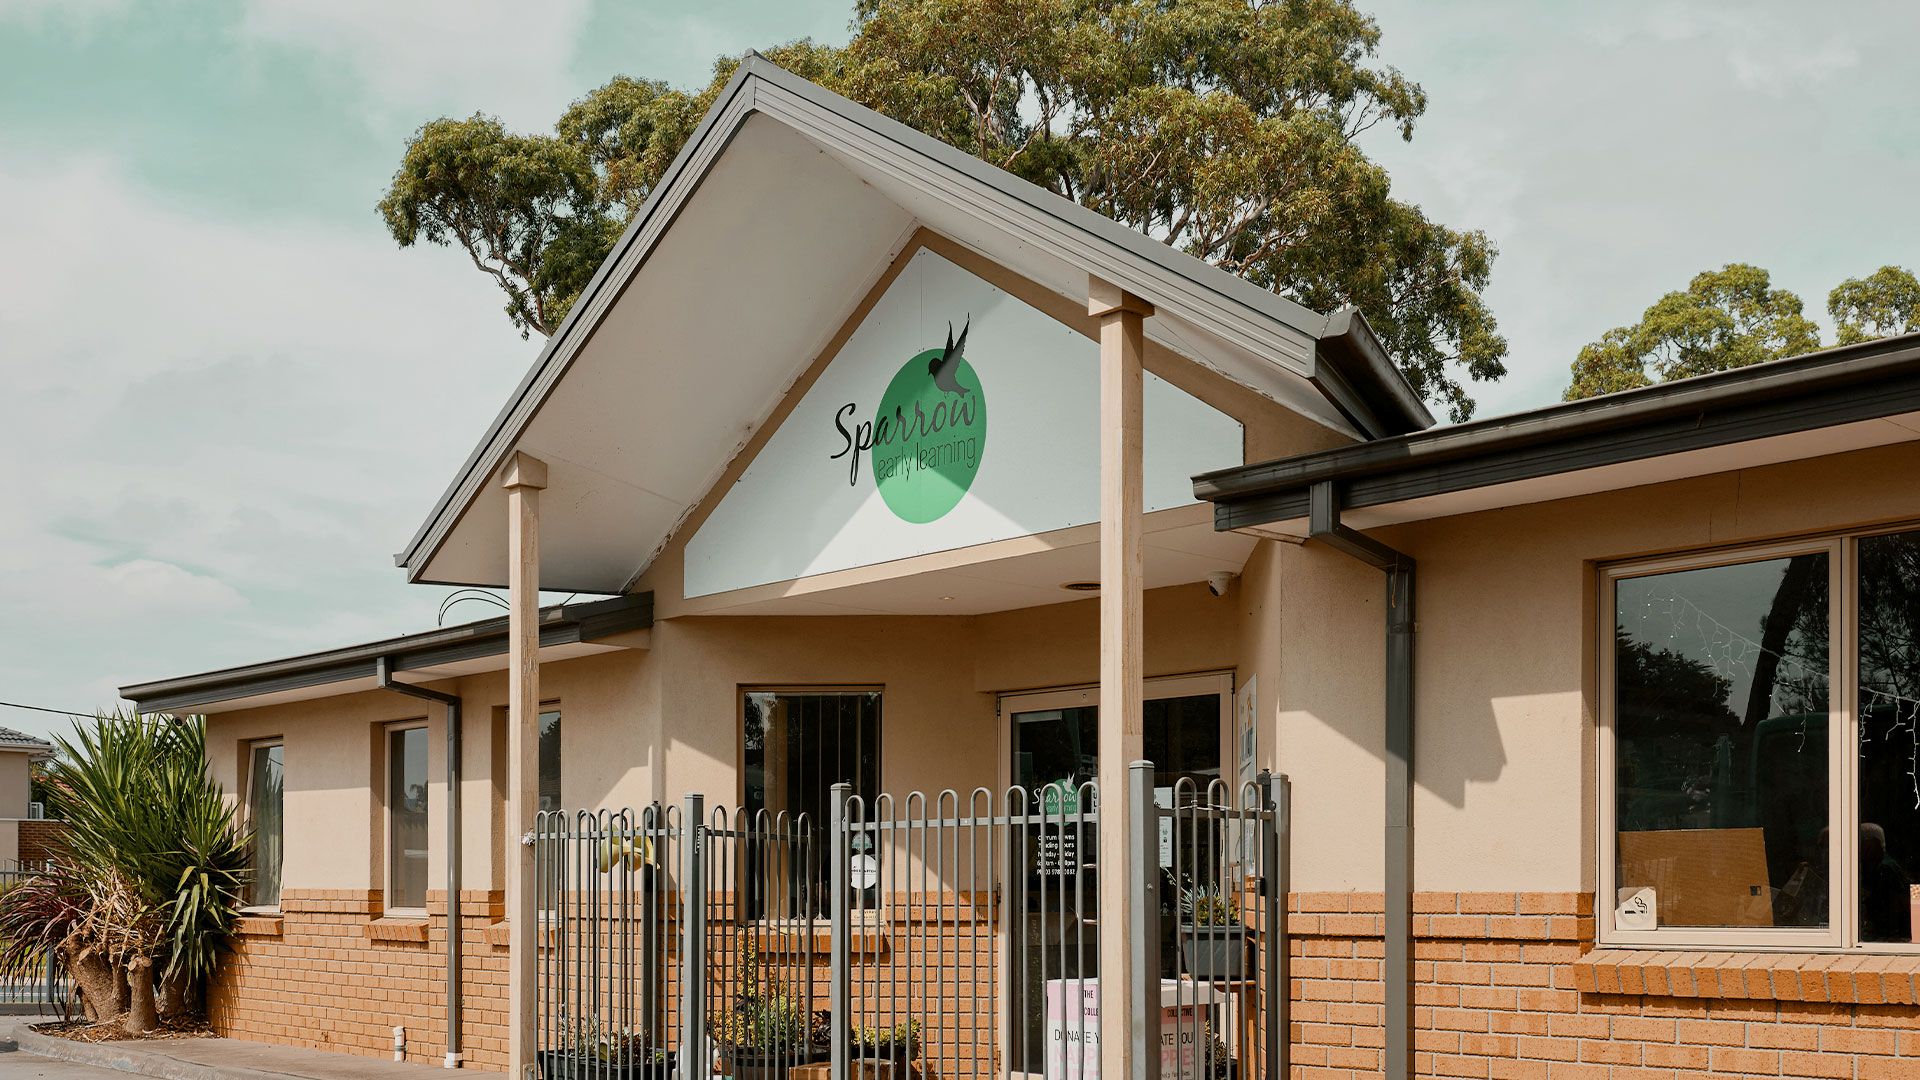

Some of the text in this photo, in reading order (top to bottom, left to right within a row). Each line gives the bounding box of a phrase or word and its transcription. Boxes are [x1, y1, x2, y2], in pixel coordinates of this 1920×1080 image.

[830, 395, 976, 486] Sparrow
[878, 435, 976, 482] early learning
[1032, 788, 1077, 812] Sarow
[1054, 1029, 1092, 1044] DNAE
